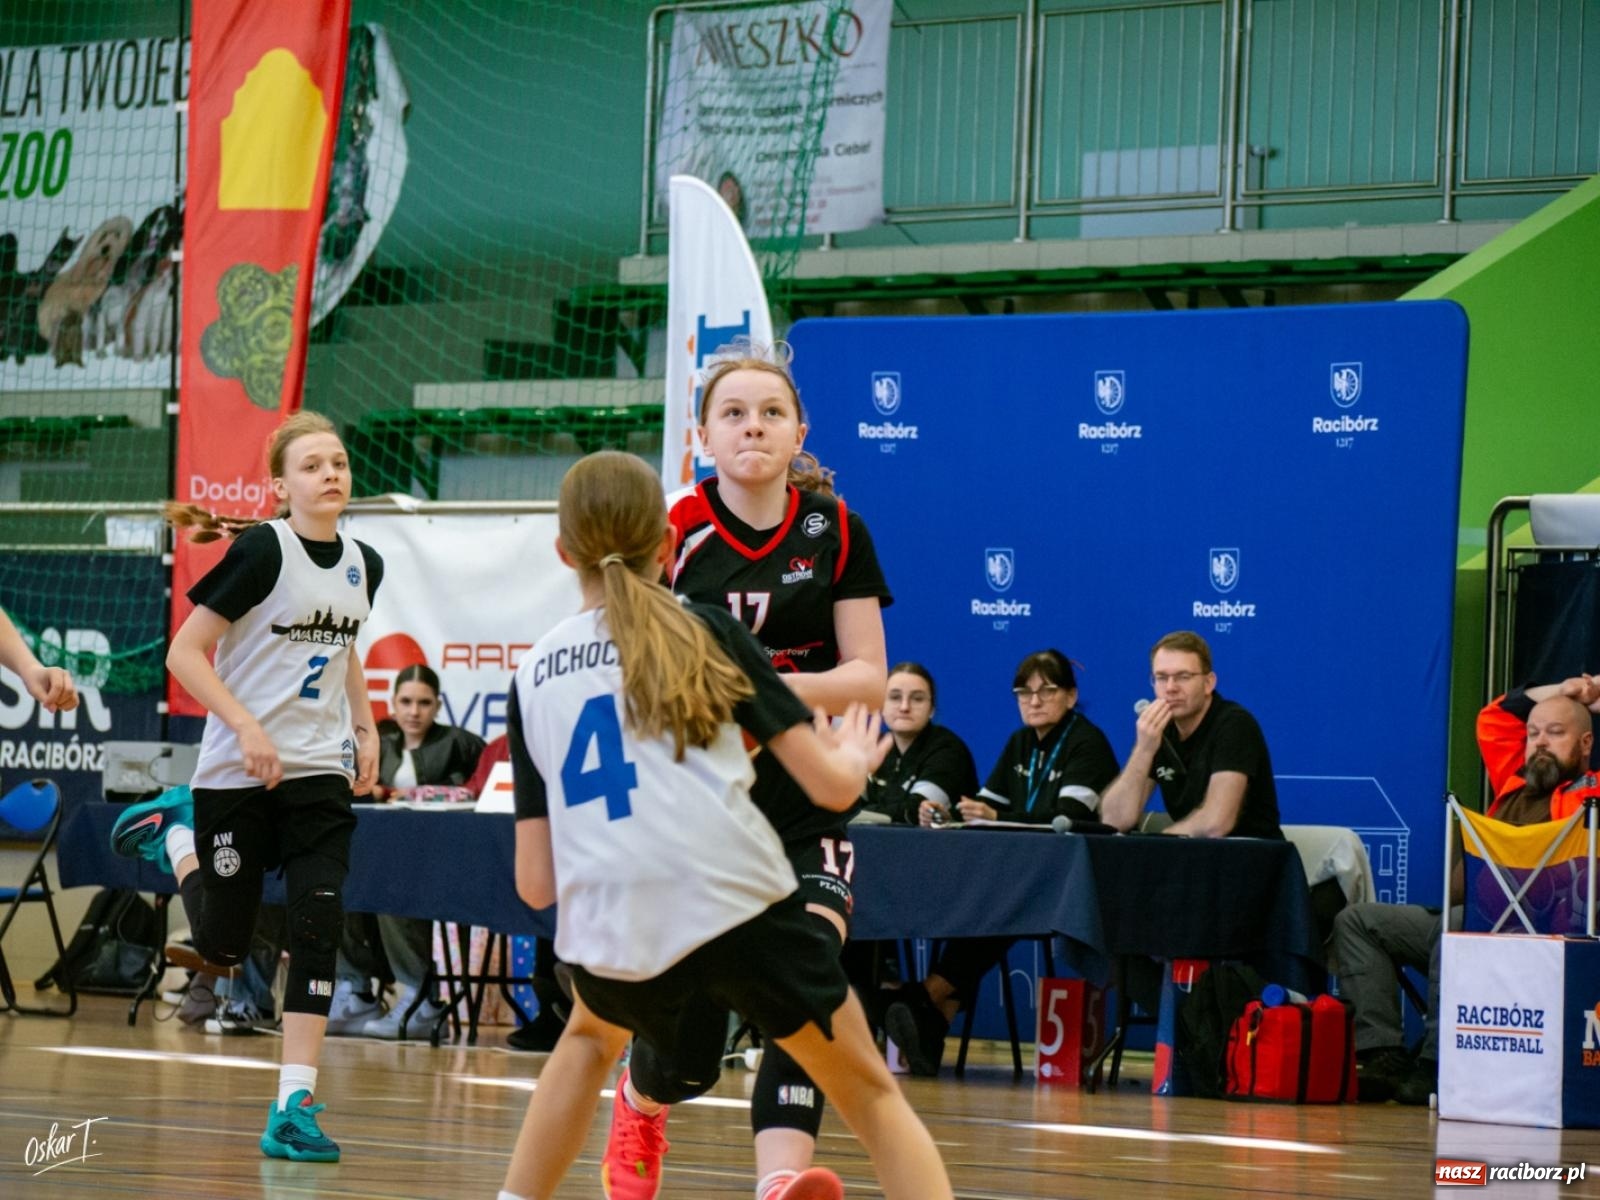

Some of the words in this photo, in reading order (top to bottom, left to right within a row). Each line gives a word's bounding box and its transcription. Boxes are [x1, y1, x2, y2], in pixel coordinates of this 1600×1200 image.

[0, 50, 42, 117] LA
[0, 129, 73, 199] ZOO
[858, 422, 918, 439] Racibórz
[1078, 422, 1142, 439] Racibórz
[1312, 415, 1379, 433] Racibórz
[191, 475, 266, 508] Dodaj
[727, 593, 770, 635] 17
[971, 599, 1031, 616] Racibórz
[1193, 600, 1256, 617] Racibórz
[299, 656, 329, 699] 2
[534, 640, 622, 688] CICHOC
[561, 694, 638, 821] 4
[213, 832, 233, 848] AW
[821, 838, 854, 884] 17
[1040, 989, 1068, 1056] 5
[1457, 1003, 1544, 1029] RACIBÓRZ
[1456, 1034, 1543, 1054] BASKETBALL
[790, 1086, 814, 1108] NBA
